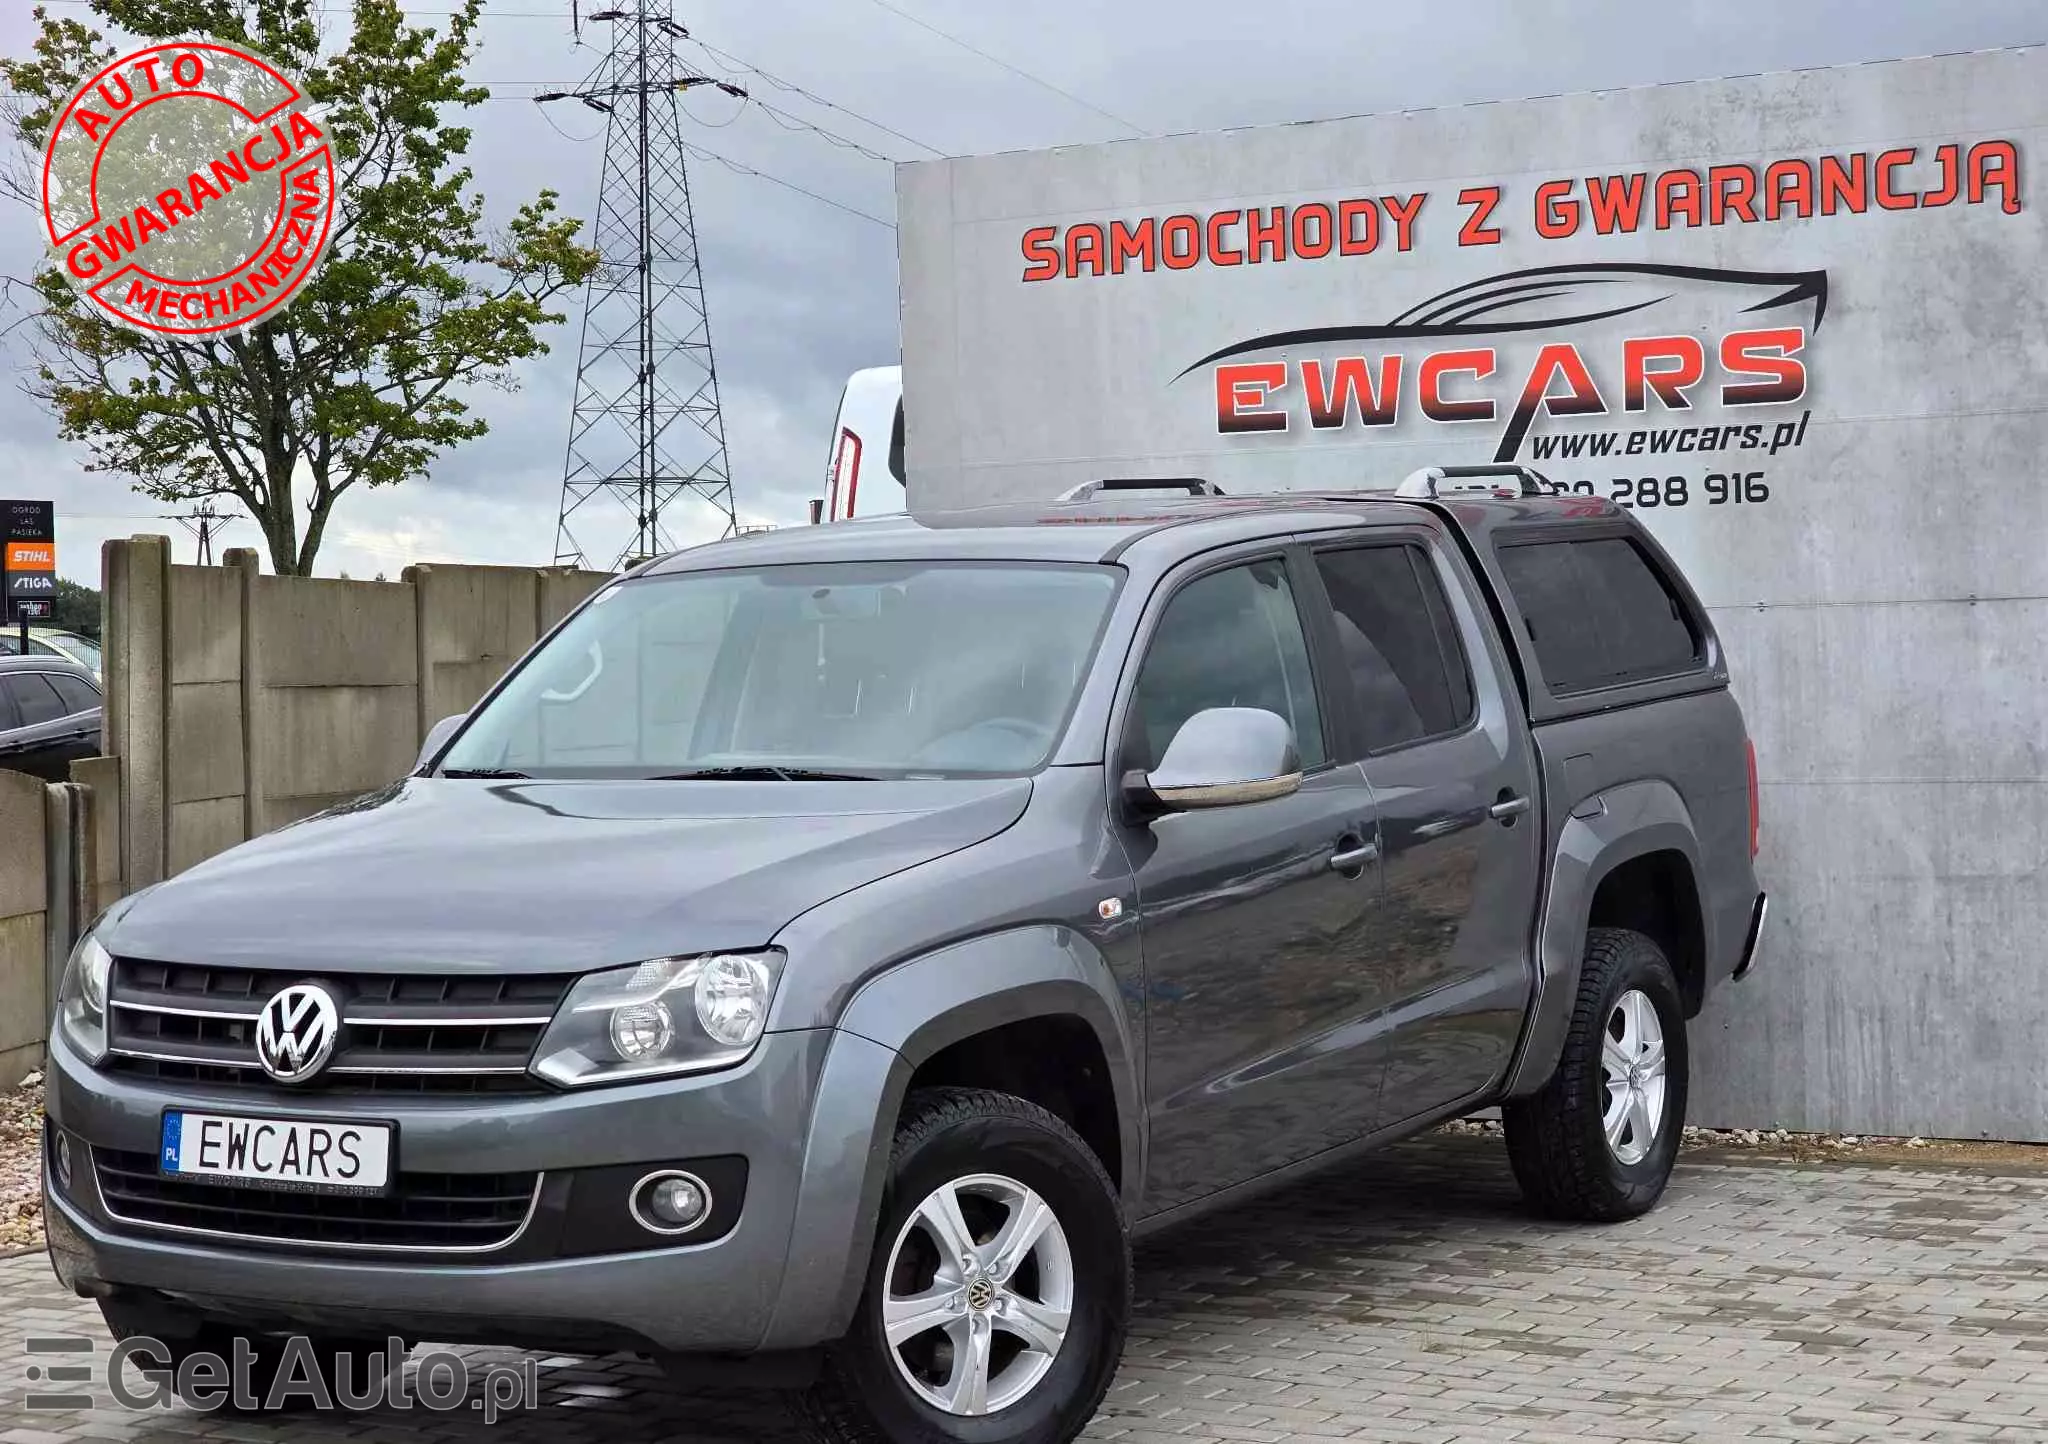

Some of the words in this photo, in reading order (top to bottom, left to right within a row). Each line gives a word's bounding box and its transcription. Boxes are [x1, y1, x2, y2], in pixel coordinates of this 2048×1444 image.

[1021, 192, 1429, 282] SAMOCHODY
[1457, 186, 1502, 247] Z
[1533, 138, 2022, 240] GWARANCJĄ
[1215, 326, 1807, 463] EWCARS
[1531, 410, 1811, 460] www.ewcars.pl
[1610, 476, 1689, 509] 288
[1703, 471, 1770, 505] 916
[14, 550, 51, 562] STIHL
[14, 577, 52, 589] STIGA
[165, 1146, 179, 1162] PL
[199, 1119, 362, 1179] EWCARS
